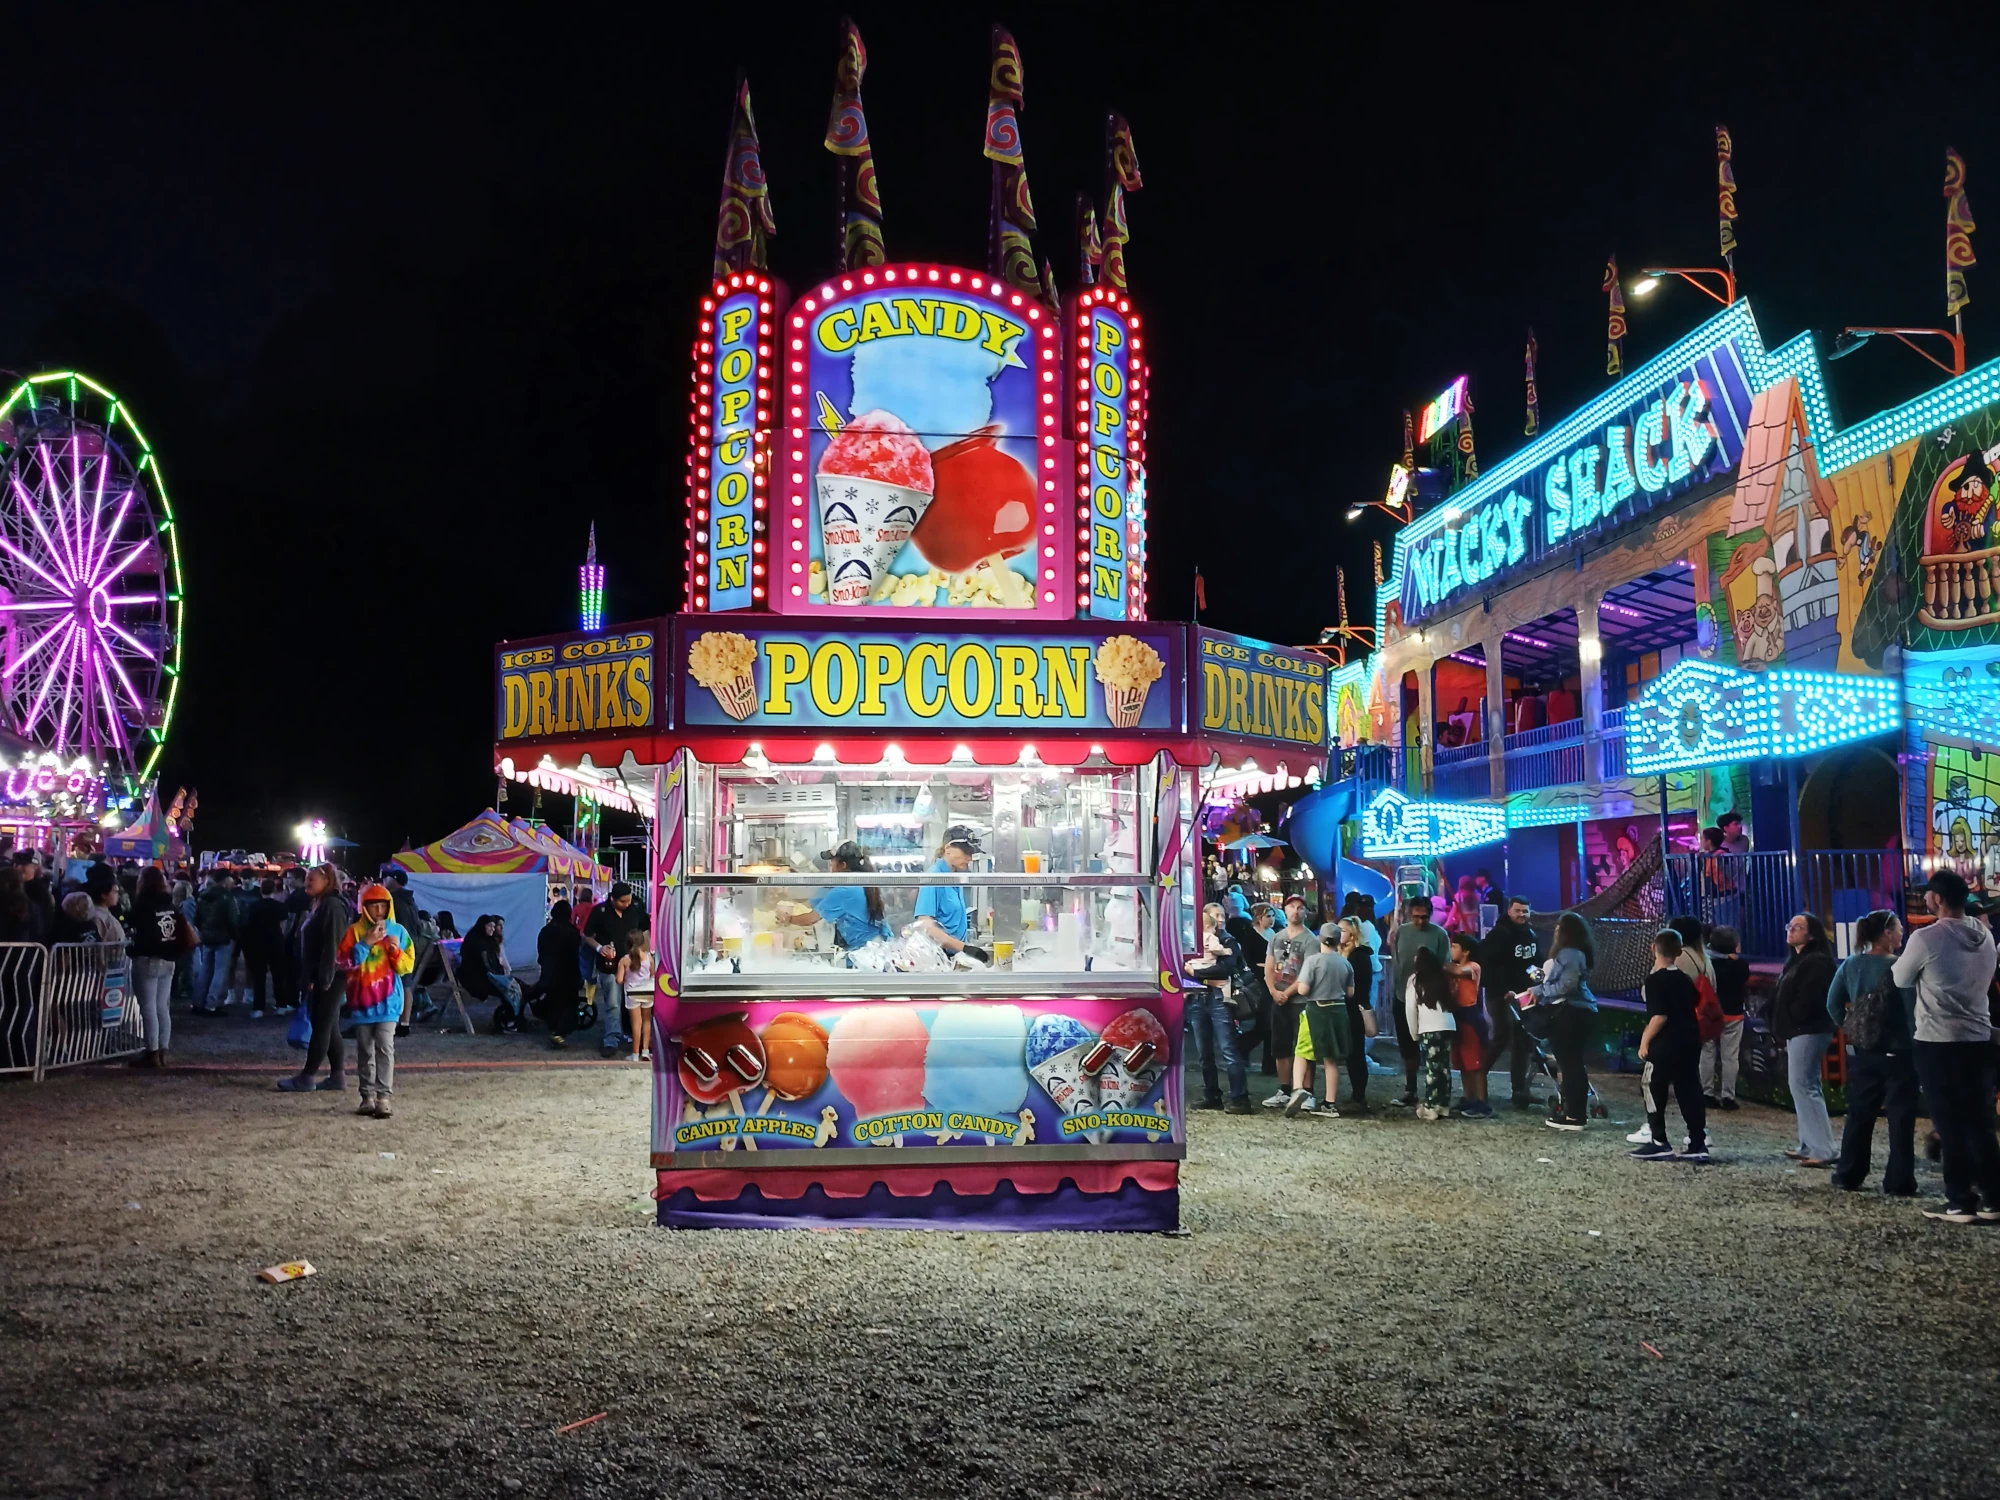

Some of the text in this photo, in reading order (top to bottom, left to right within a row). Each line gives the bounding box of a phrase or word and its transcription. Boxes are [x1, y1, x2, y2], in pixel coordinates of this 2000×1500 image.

[817, 299, 1025, 356] CANDY
[717, 307, 752, 590] POPCORN
[1095, 319, 1124, 600] POPCORN
[1410, 379, 1716, 608] WACKY SHACK
[502, 634, 652, 670] ICE COLD
[764, 641, 1090, 718] POPCORN
[1202, 638, 1324, 678] ICE COLD
[503, 655, 651, 738] DRINKS
[1203, 662, 1323, 746] DRINKS
[676, 1116, 816, 1143] CANDY APPLES
[854, 1112, 1018, 1141] COTTON CANDY
[1063, 1113, 1170, 1135] SNO-KONES
